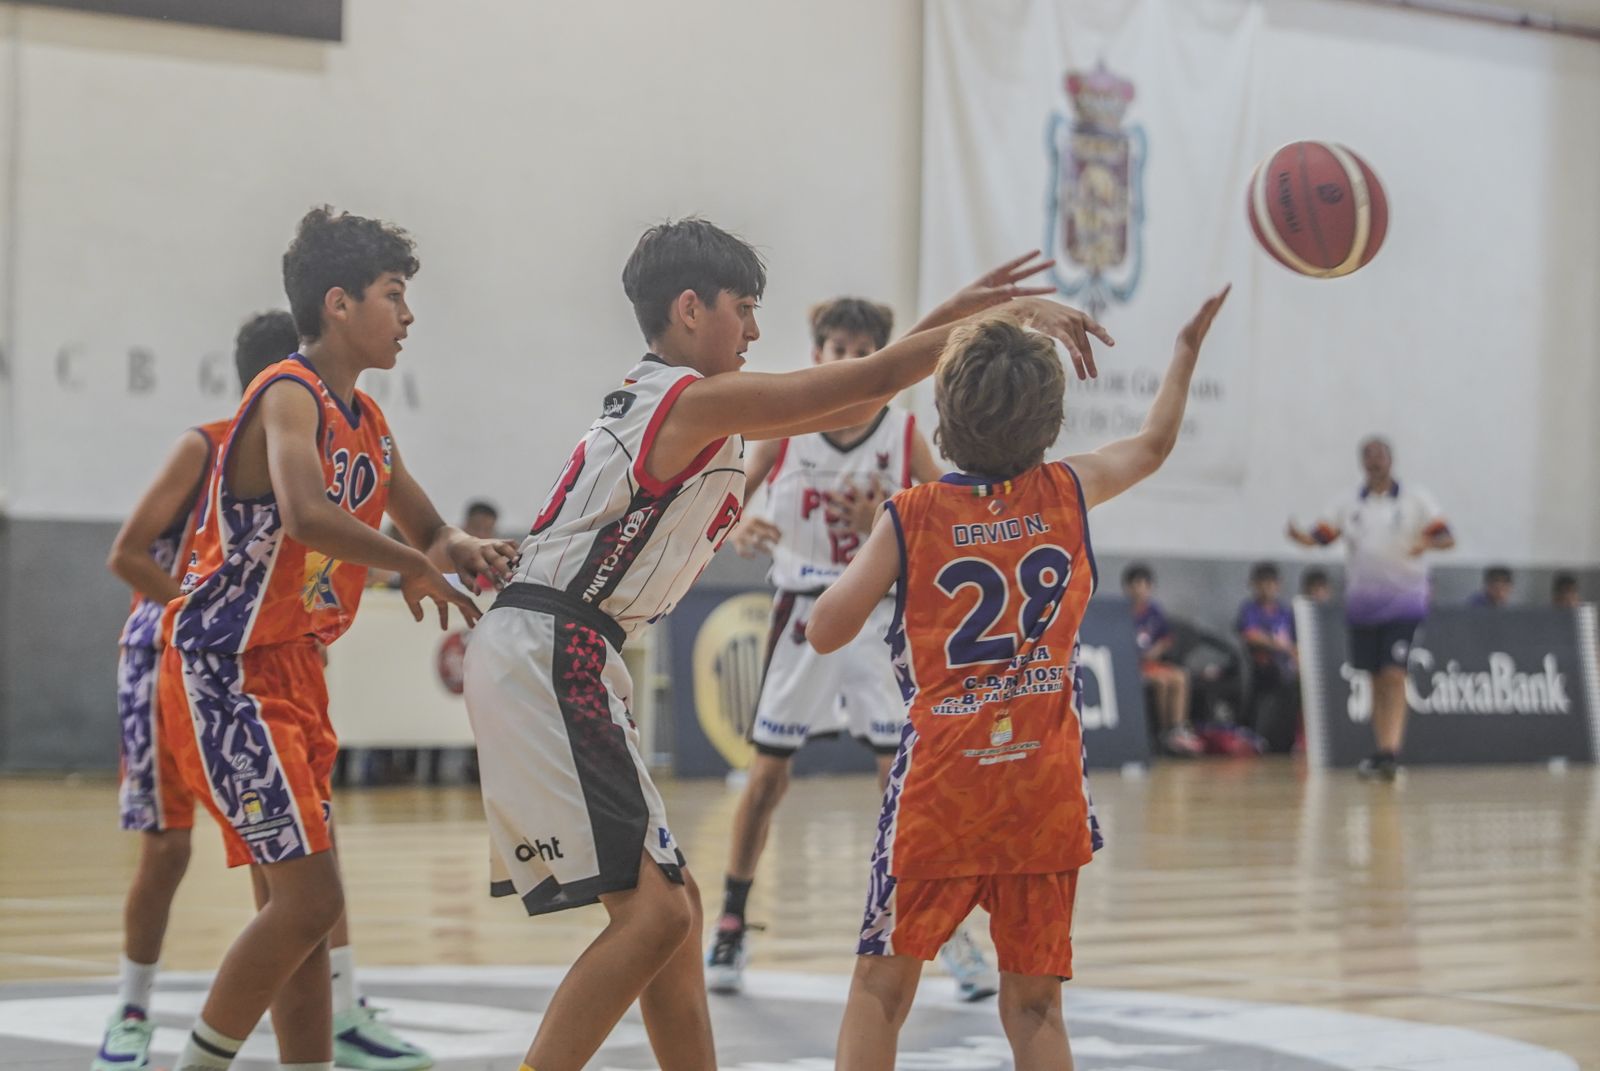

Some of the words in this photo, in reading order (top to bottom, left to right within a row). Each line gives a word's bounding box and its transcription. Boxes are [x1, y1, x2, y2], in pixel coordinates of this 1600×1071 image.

[326, 447, 378, 513] 30
[953, 518, 1021, 547] DAVID
[1026, 513, 1050, 535] N.
[933, 543, 1073, 669] 28
[1404, 646, 1570, 715] CaixaBank
